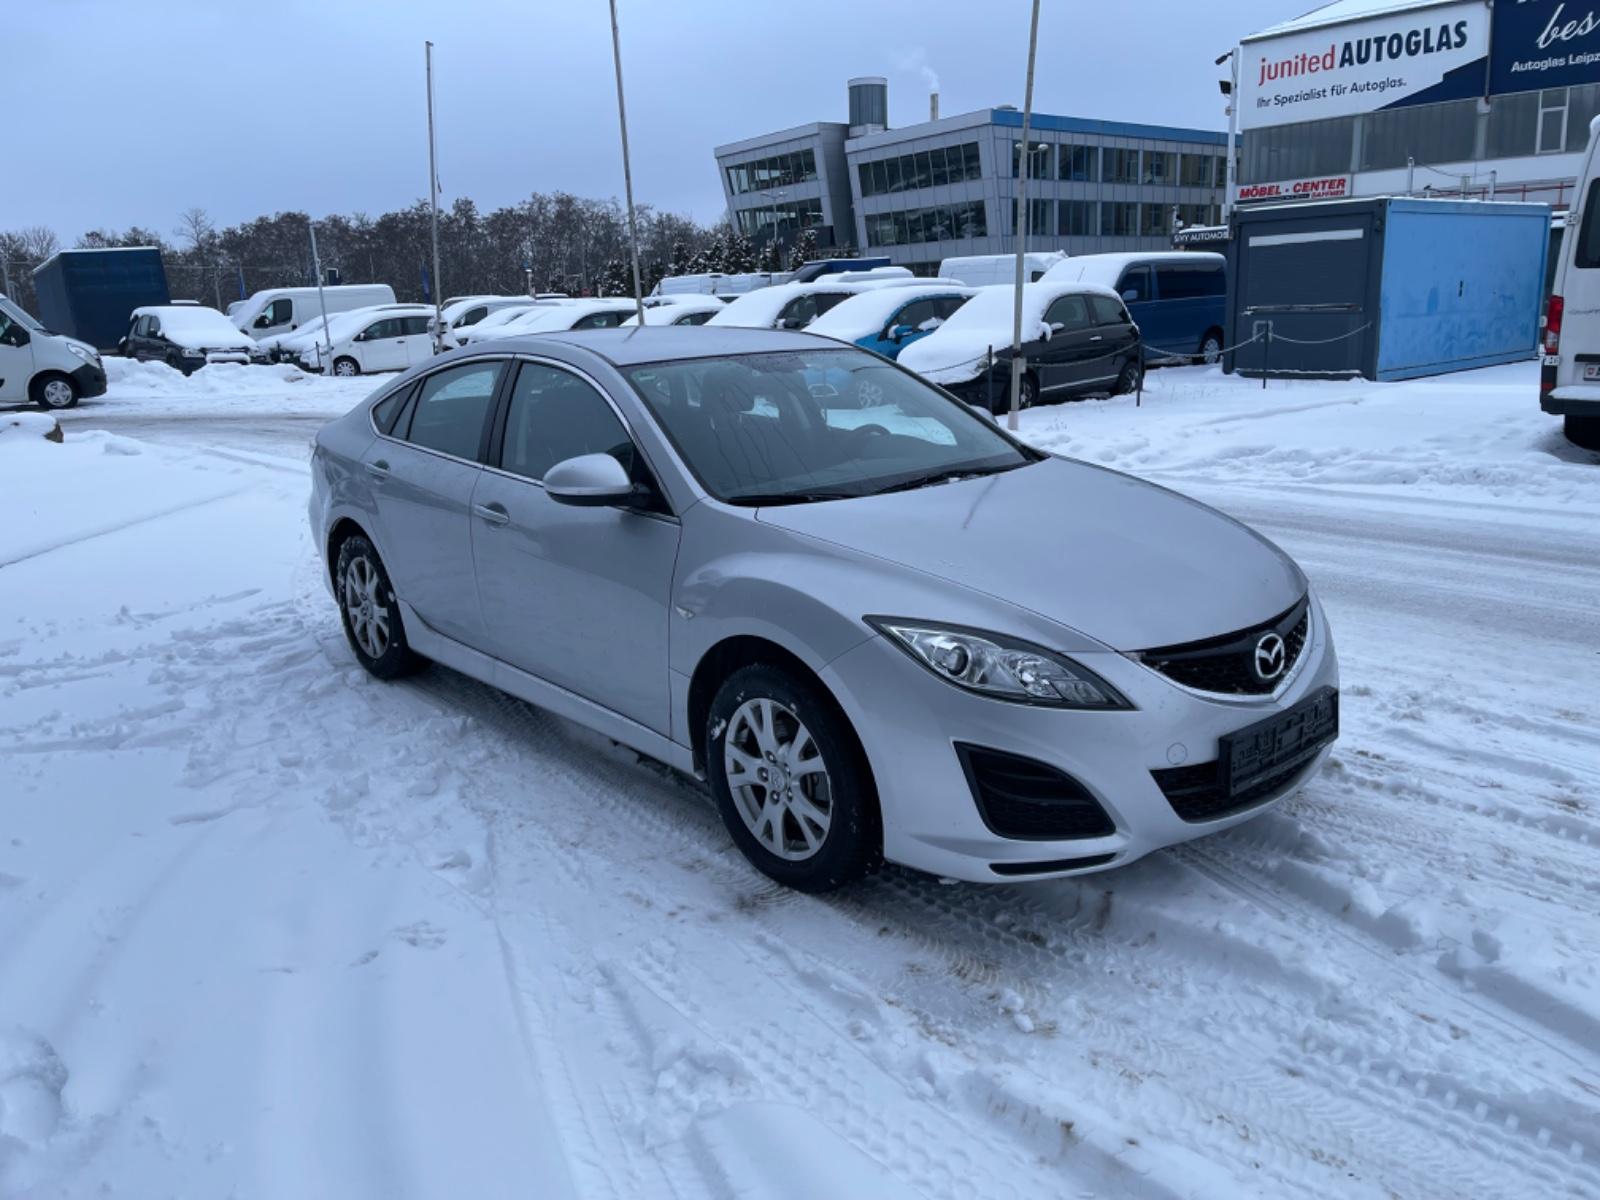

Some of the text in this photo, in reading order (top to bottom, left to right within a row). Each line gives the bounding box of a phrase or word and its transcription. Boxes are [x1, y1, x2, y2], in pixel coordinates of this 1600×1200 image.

[1258, 20, 1468, 87] junited AUTOGLAS
[1511, 57, 1566, 72] Autoglas
[1256, 77, 1407, 109] Ihr Spezialist für Autoglas.
[1239, 184, 1282, 199] MÖBEL
[1293, 178, 1346, 193] CENTER
